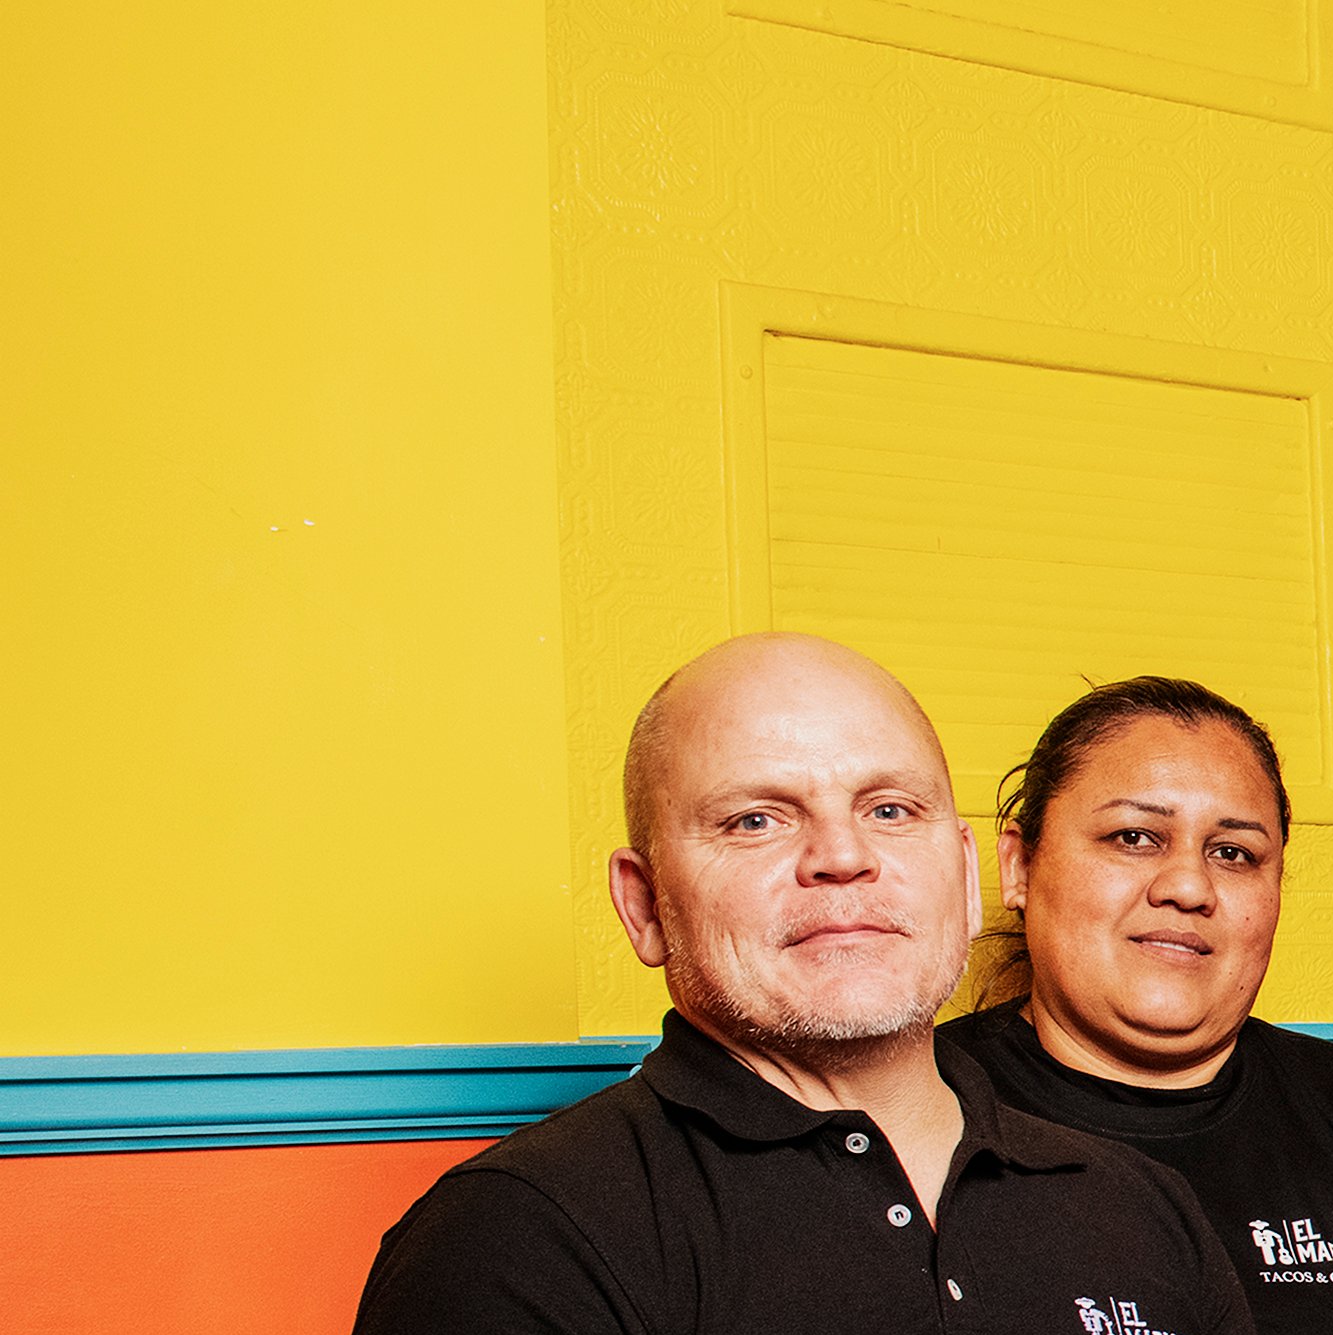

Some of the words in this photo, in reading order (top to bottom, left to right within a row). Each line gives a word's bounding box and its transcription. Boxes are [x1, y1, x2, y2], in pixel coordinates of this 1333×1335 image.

[1291, 1218, 1321, 1242] EL
[1260, 1271, 1314, 1283] TACOS
[1315, 1271, 1329, 1284] &
[1118, 1301, 1147, 1327] EL
